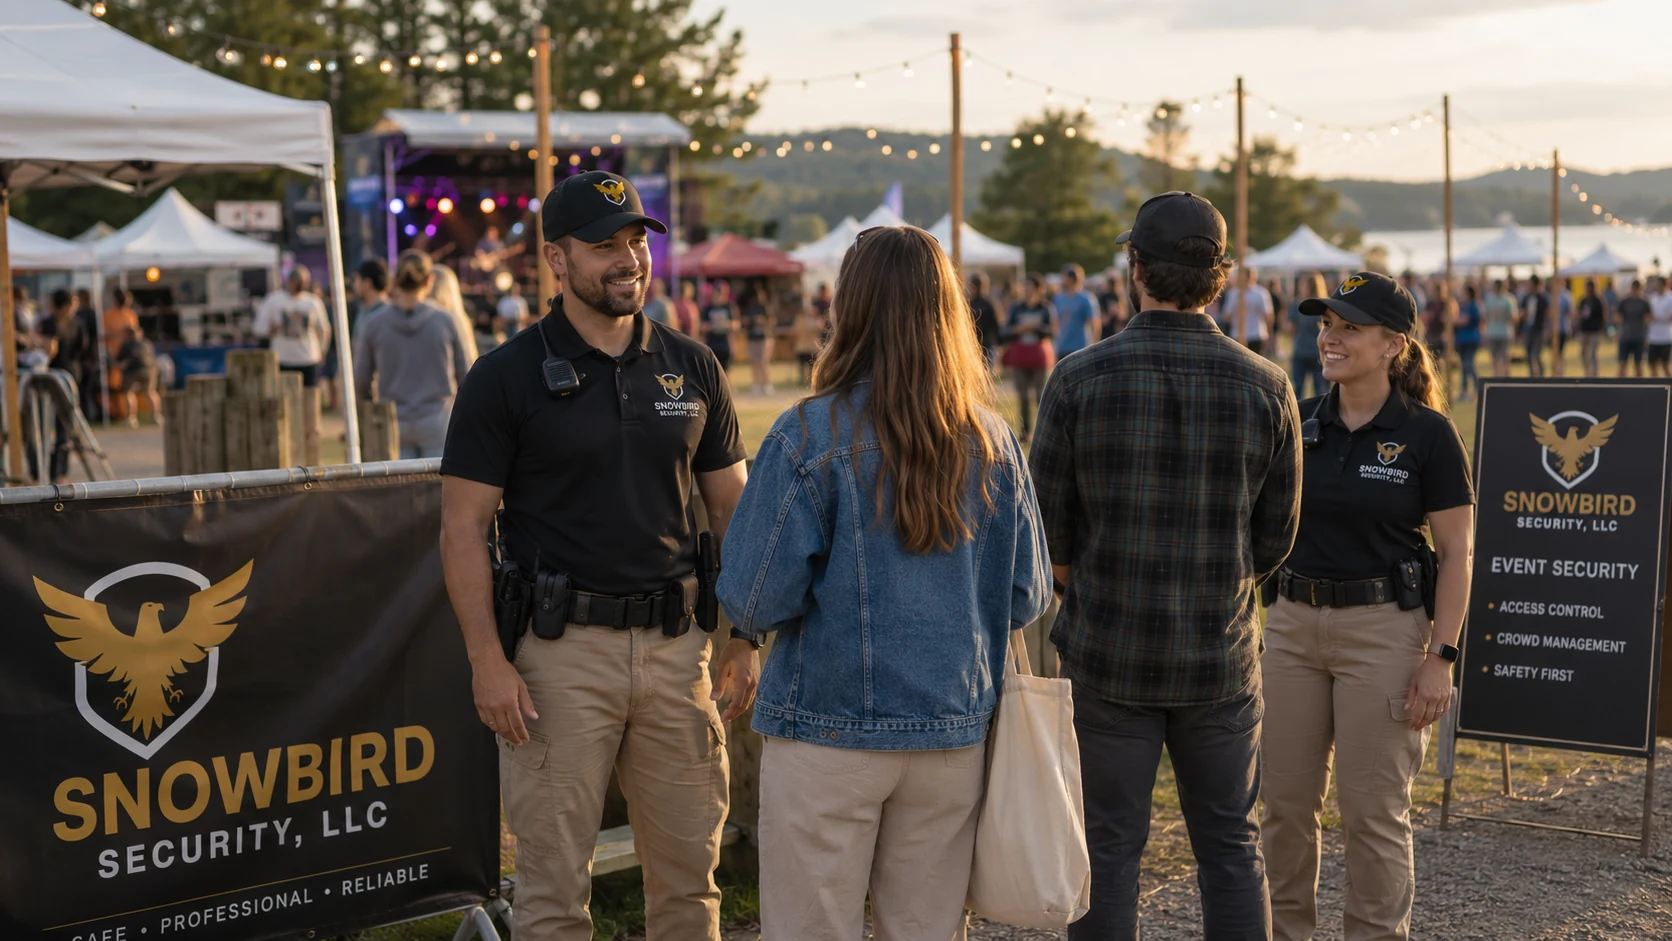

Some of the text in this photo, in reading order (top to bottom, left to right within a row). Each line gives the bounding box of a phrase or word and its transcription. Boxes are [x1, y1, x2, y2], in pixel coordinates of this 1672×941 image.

[1359, 464, 1409, 479] SNOWBIRD
[1503, 490, 1637, 516] SNOWBIRD
[1516, 516, 1618, 532] SECURITY, LLC
[1491, 556, 1639, 580] EVENT SECURITY
[1499, 600, 1604, 619] ACCESS CONTROL
[1496, 632, 1627, 654] CROWD MANAGEMENT
[1494, 664, 1575, 682] SAFETY FIRST
[52, 725, 435, 842] SNOWBIRD
[98, 800, 388, 879] SECURITY, LLC
[160, 888, 314, 934] PROFESSIONAL
[341, 863, 430, 896] RELIABLE
